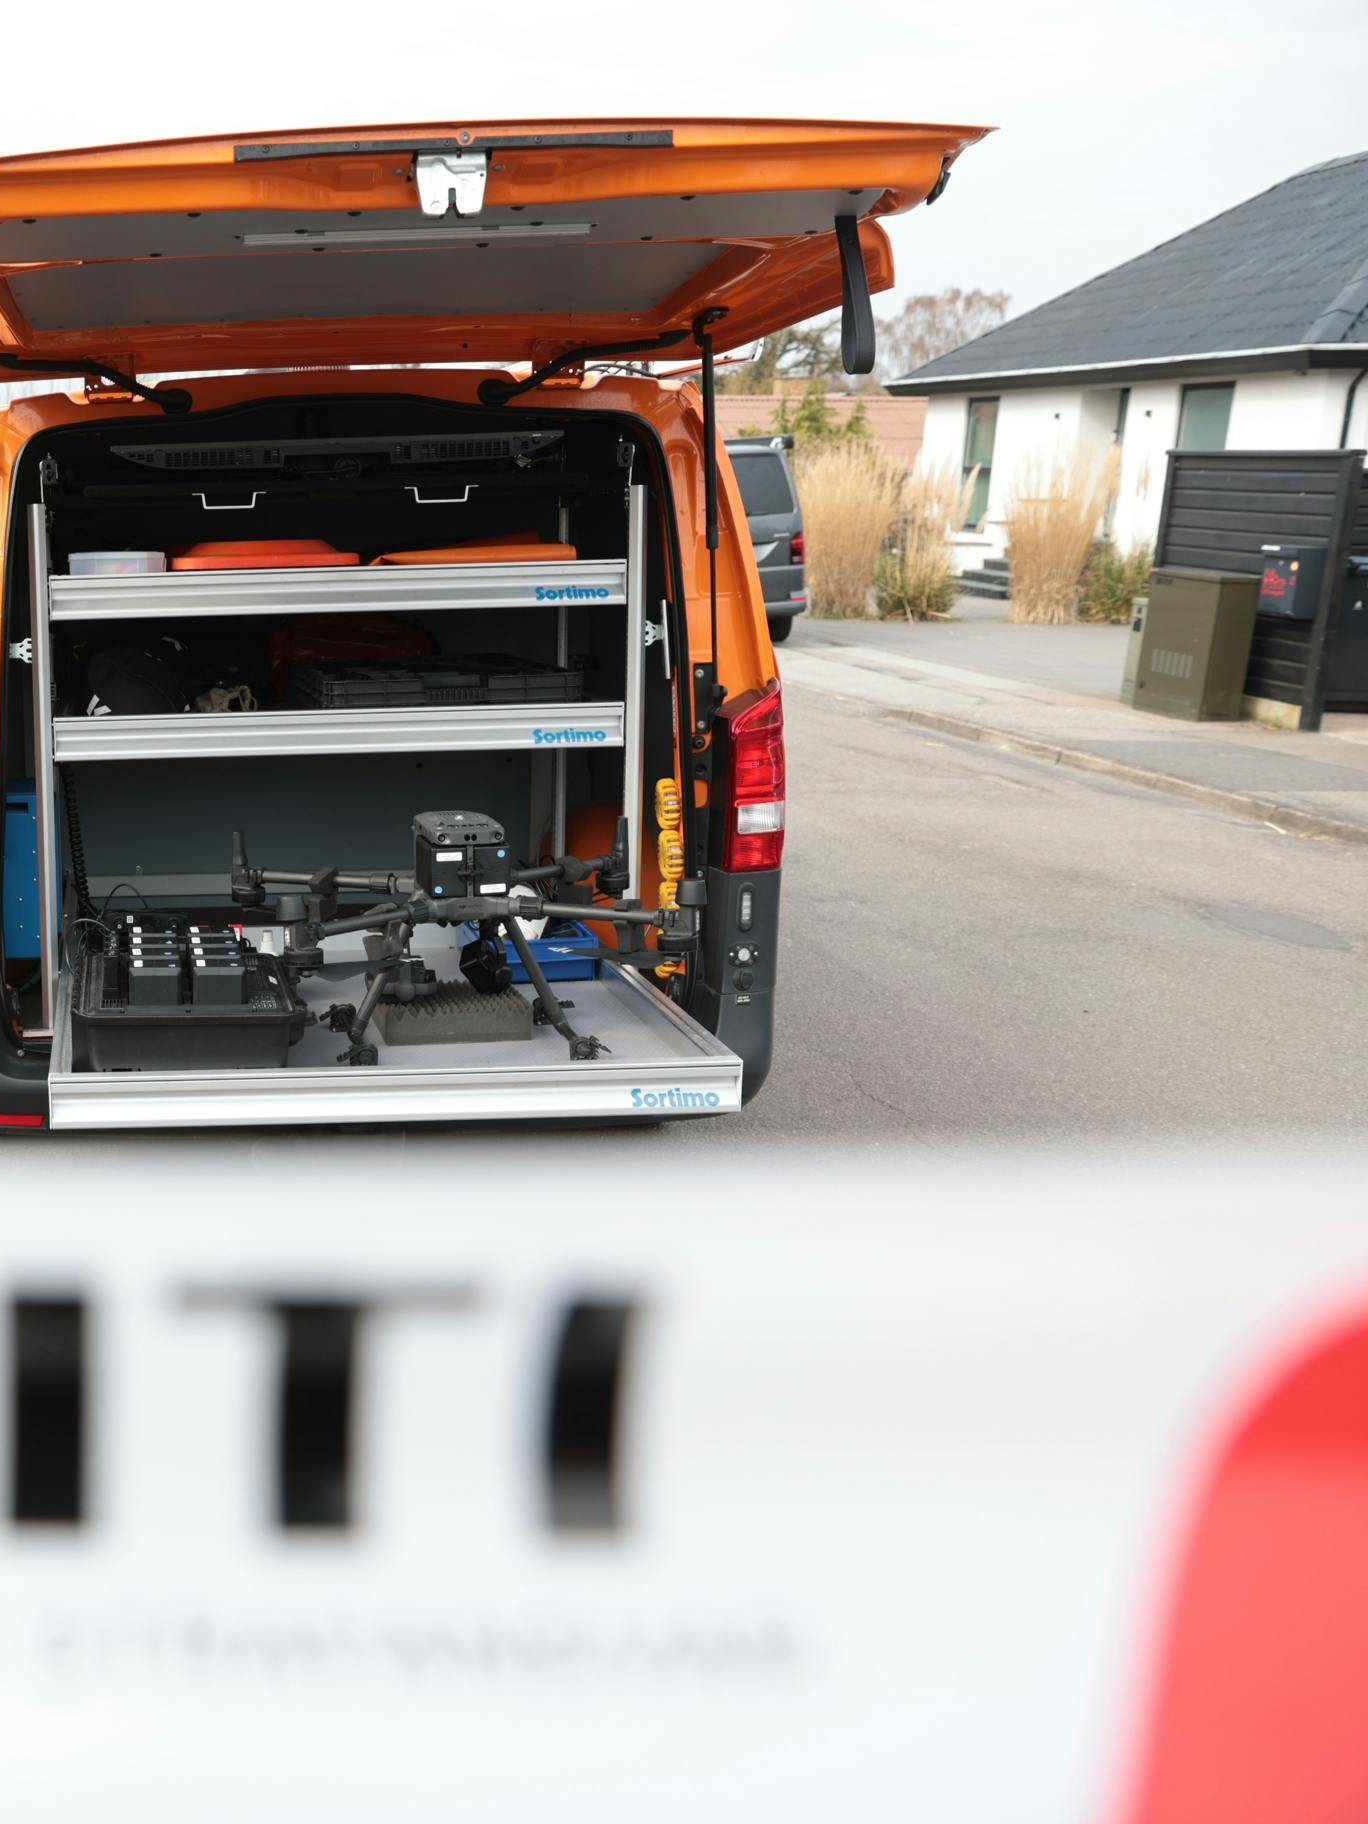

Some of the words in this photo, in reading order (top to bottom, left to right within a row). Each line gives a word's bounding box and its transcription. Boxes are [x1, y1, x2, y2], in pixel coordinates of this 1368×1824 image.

[535, 585, 609, 601] Sortimo
[533, 727, 606, 744] Sortimo
[631, 1087, 720, 1107] Sortimo
